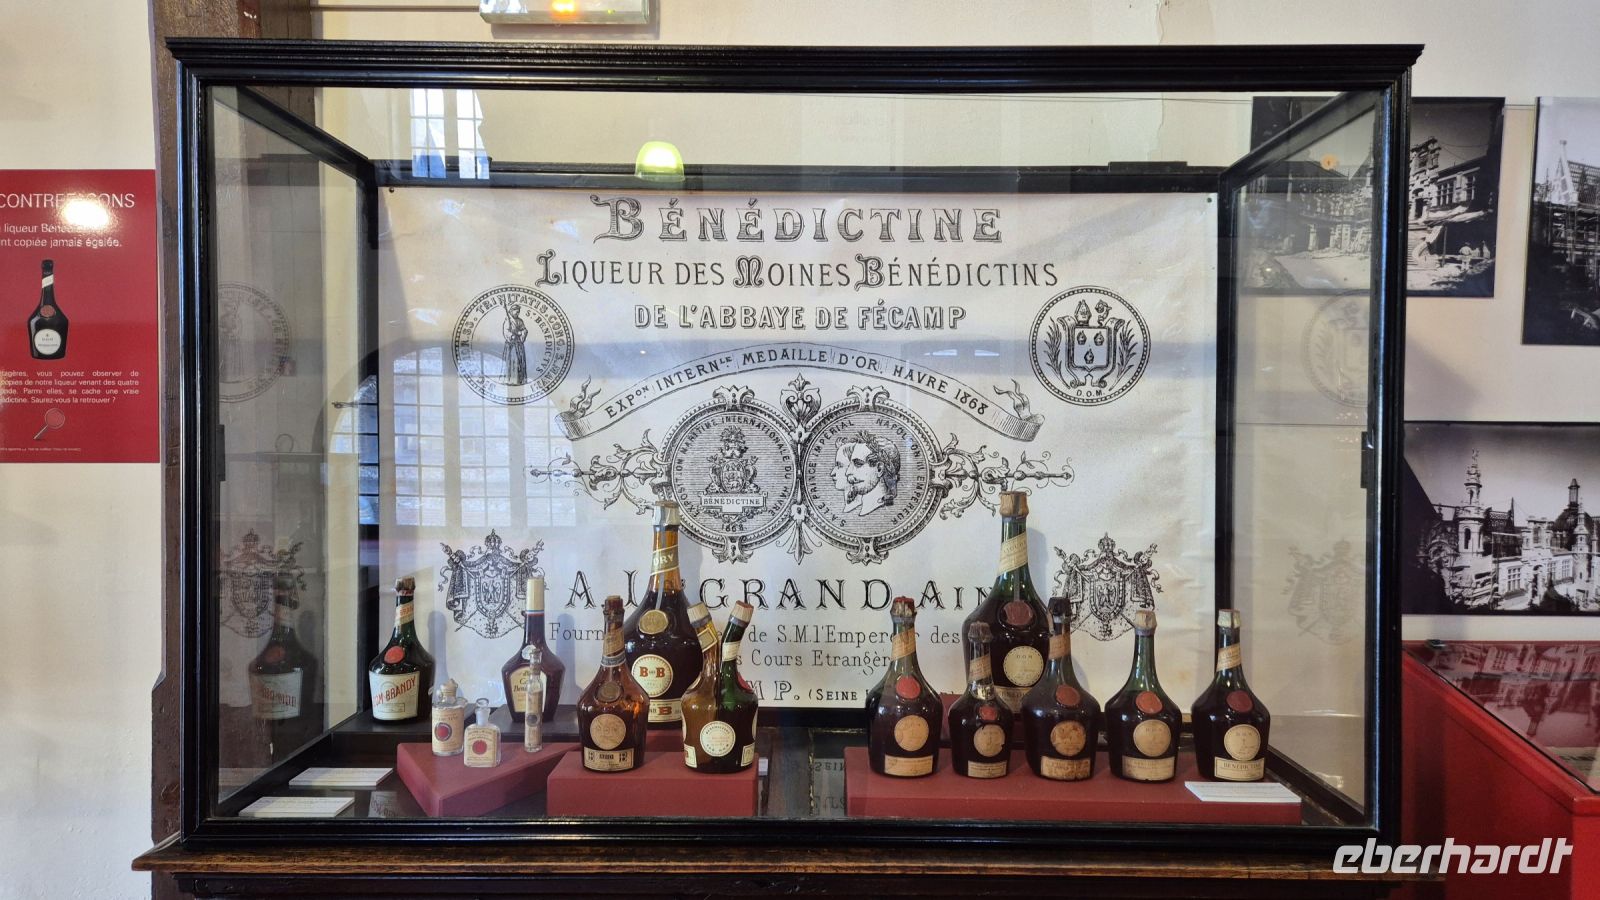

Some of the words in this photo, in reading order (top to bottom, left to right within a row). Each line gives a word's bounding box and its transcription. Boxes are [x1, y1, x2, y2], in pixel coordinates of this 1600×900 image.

[0, 193, 135, 209] CONTREONS
[4, 222, 38, 235] liqueur
[590, 194, 1002, 244] BÉNÉDICTINE
[13, 237, 48, 248] copiée
[50, 237, 83, 249] jamais
[535, 248, 665, 293] LIQUEUR
[675, 261, 725, 286] DES
[732, 254, 851, 289] MOINES
[854, 253, 1058, 292] BÉNÉDICTINS
[634, 304, 668, 330] DE
[679, 304, 806, 330] L'ABBAYE
[815, 305, 849, 331] DE
[857, 298, 967, 331] FÉCAMP
[23, 387, 43, 395] Parmi
[81, 387, 101, 395] cache
[122, 387, 139, 395] vraie
[54, 379, 77, 387] liqueur
[117, 379, 139, 387] quatre
[742, 348, 828, 366] MEDAILLE
[893, 364, 949, 394] HAVRE
[953, 388, 989, 416] 1868
[748, 624, 768, 643] de
[930, 625, 960, 644] des
[751, 648, 803, 667] Cours
